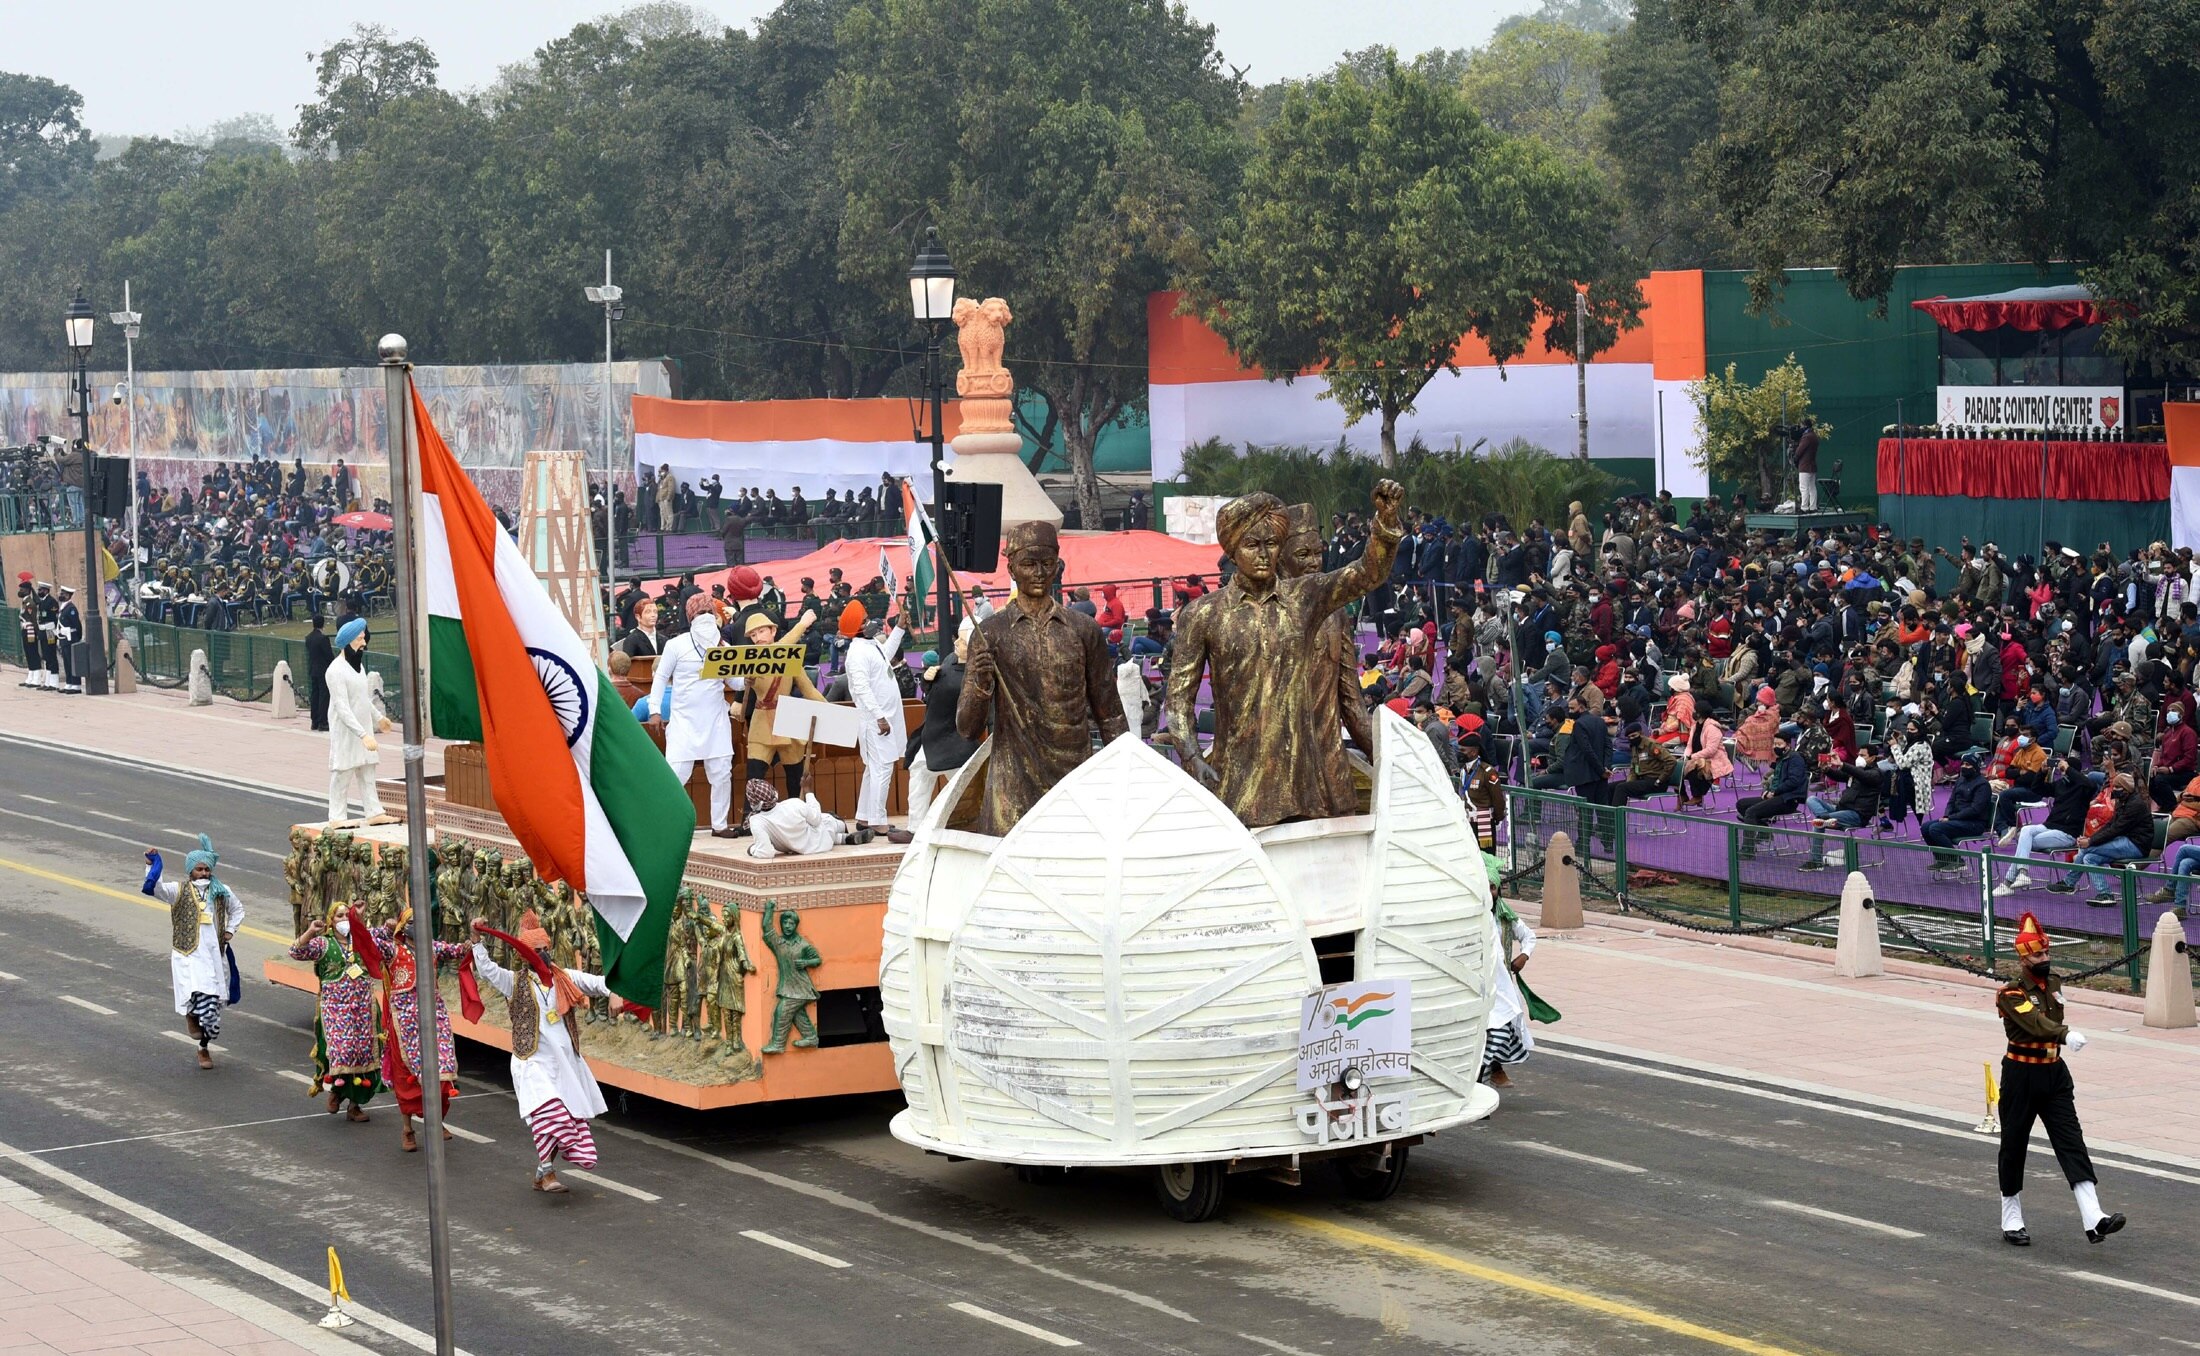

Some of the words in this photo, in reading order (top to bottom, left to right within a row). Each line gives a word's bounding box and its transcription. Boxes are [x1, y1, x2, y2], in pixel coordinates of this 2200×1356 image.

[1965, 397, 2001, 423] PARADE
[2053, 396, 2093, 425] CENTRE
[708, 649, 738, 661] GO
[745, 647, 802, 660] BACK
[718, 663, 786, 676] SIMON
[1299, 1029, 1343, 1061] आज़ादी
[1345, 1039, 1360, 1051] का
[1309, 1058, 1343, 1084] अमृत
[1296, 1087, 1416, 1145] पंजाब
